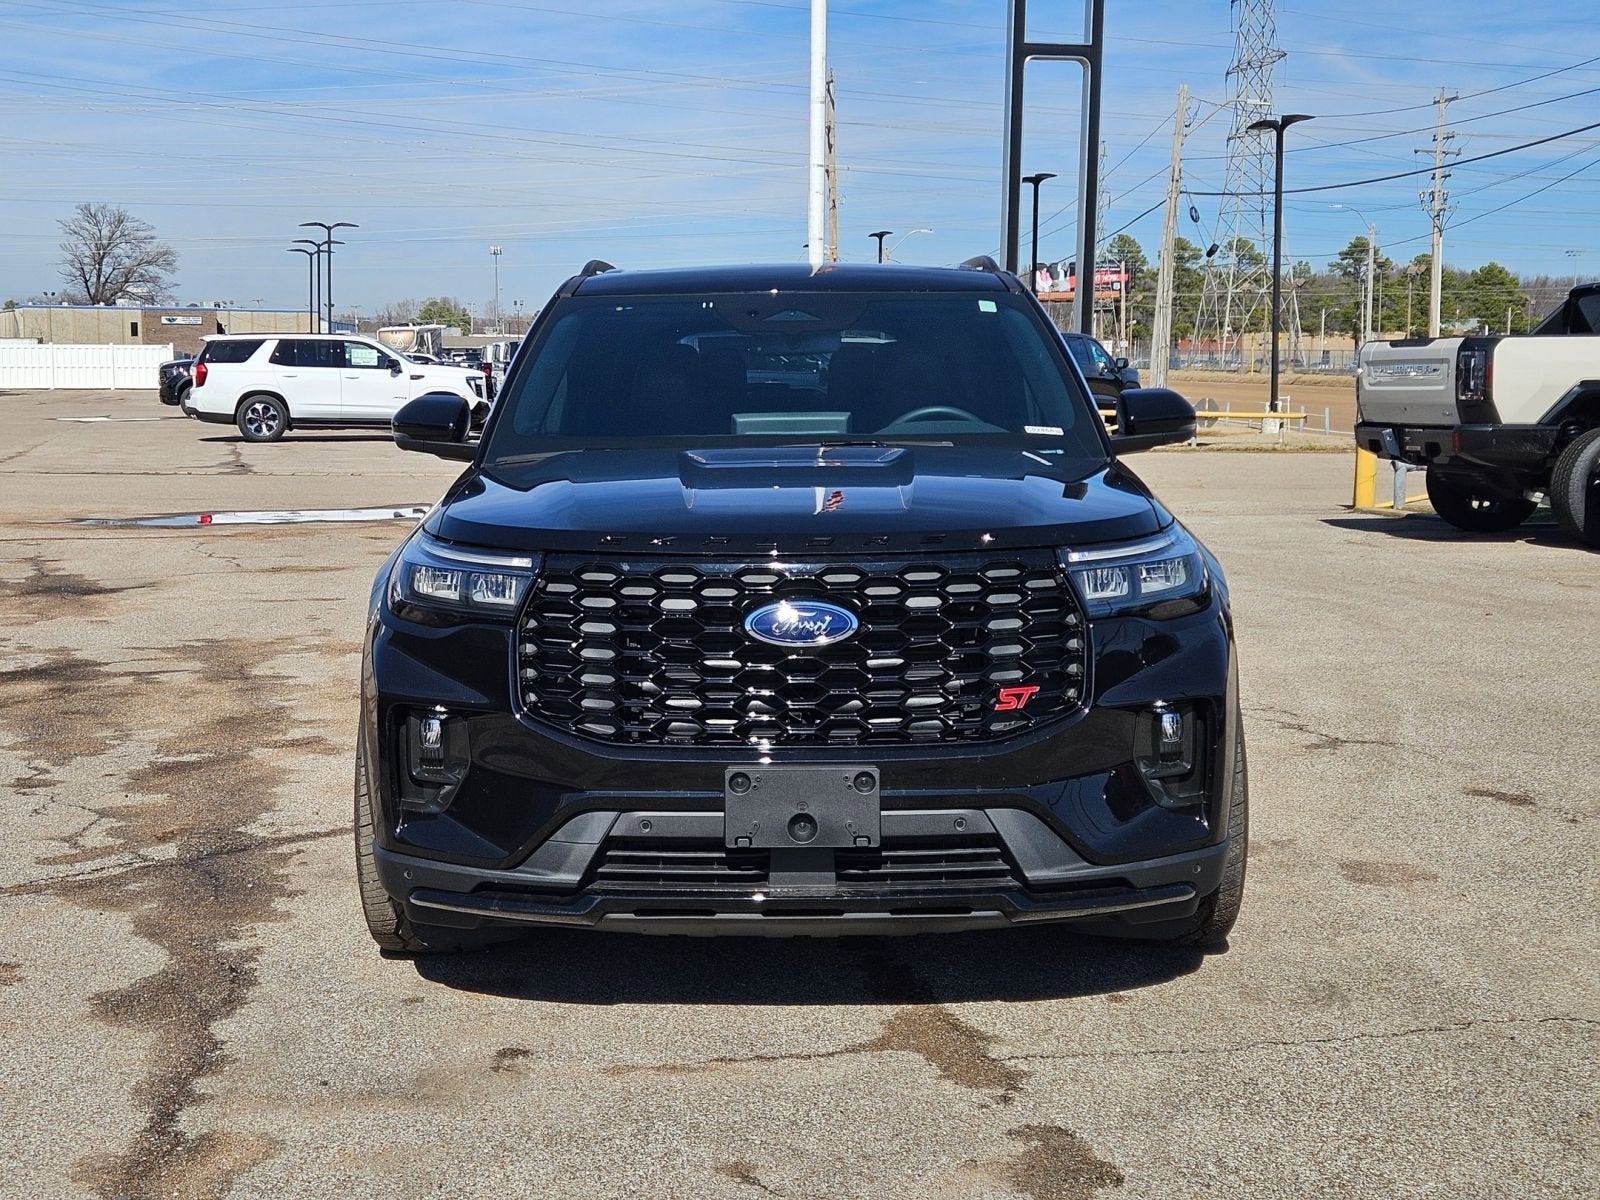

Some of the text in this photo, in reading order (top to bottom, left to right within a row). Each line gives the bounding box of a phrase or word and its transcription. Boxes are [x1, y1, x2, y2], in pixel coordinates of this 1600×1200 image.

[598, 532, 996, 546] EXPLORE
[771, 609, 832, 637] Ford
[994, 686, 1040, 711] ST
